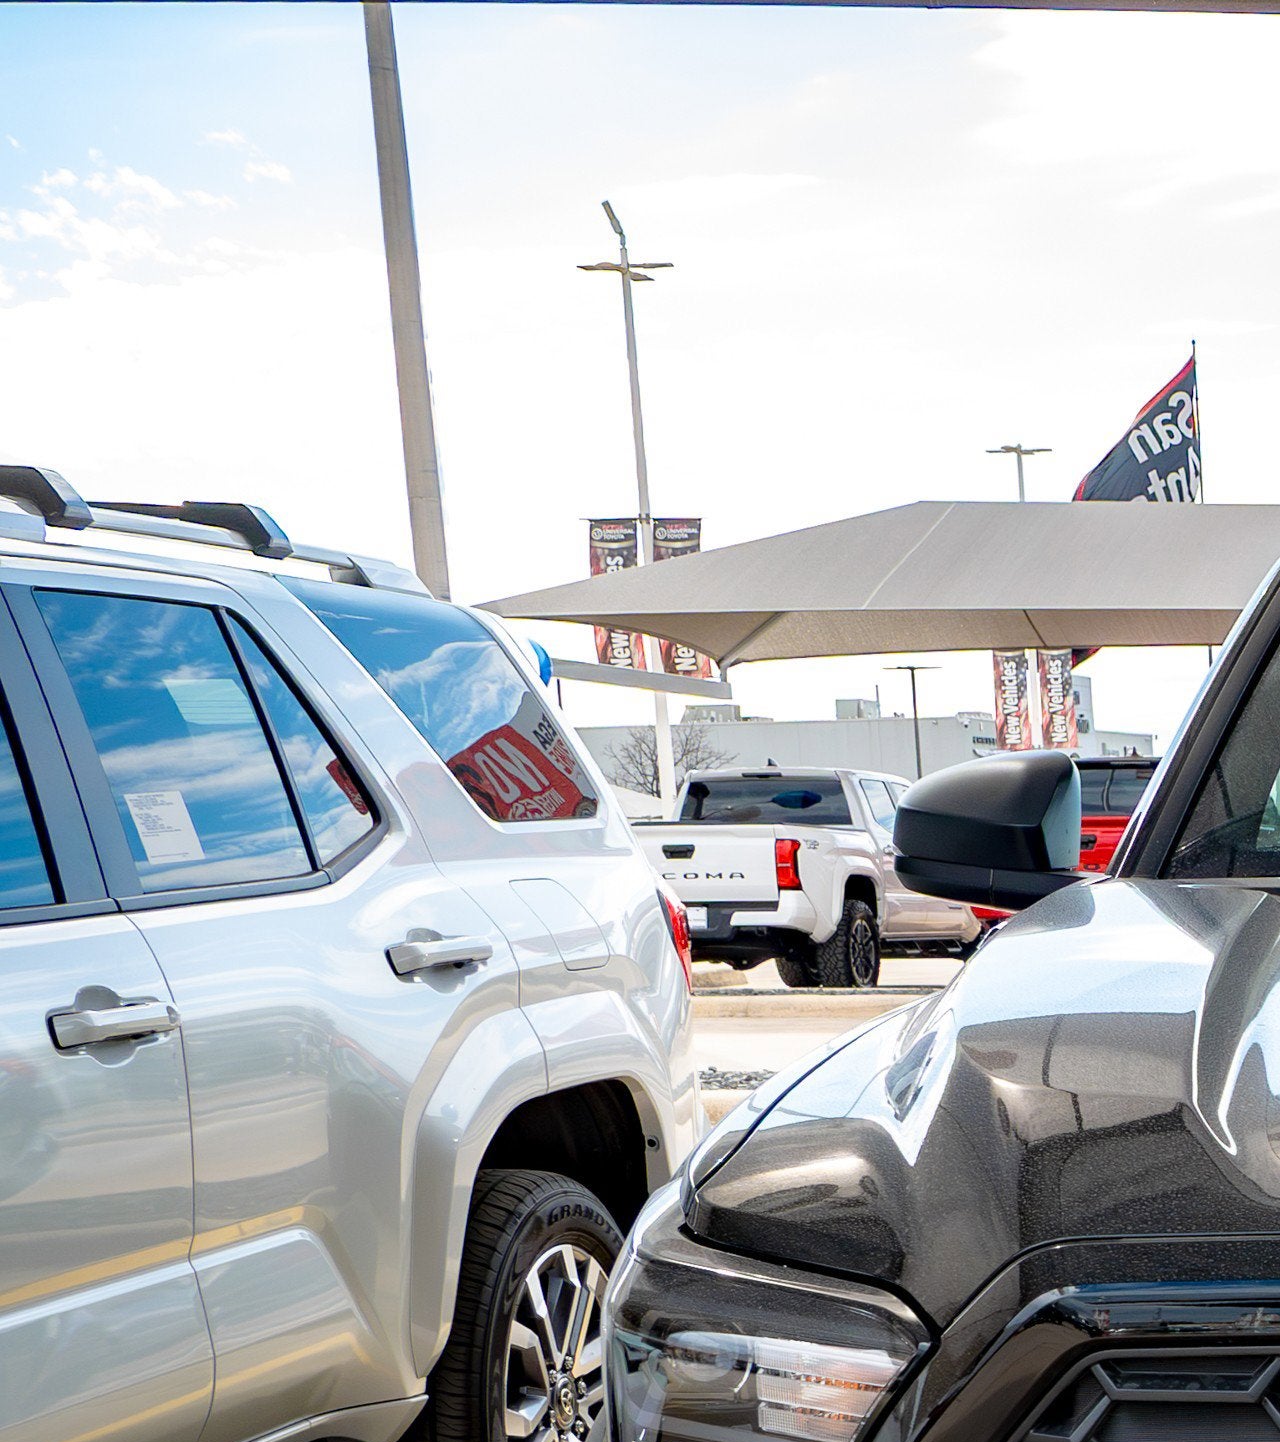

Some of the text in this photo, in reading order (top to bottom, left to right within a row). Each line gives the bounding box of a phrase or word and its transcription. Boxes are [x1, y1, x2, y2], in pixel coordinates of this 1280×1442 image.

[1001, 660, 1022, 745] New Vehicles
[1046, 658, 1068, 743] New Vehicles
